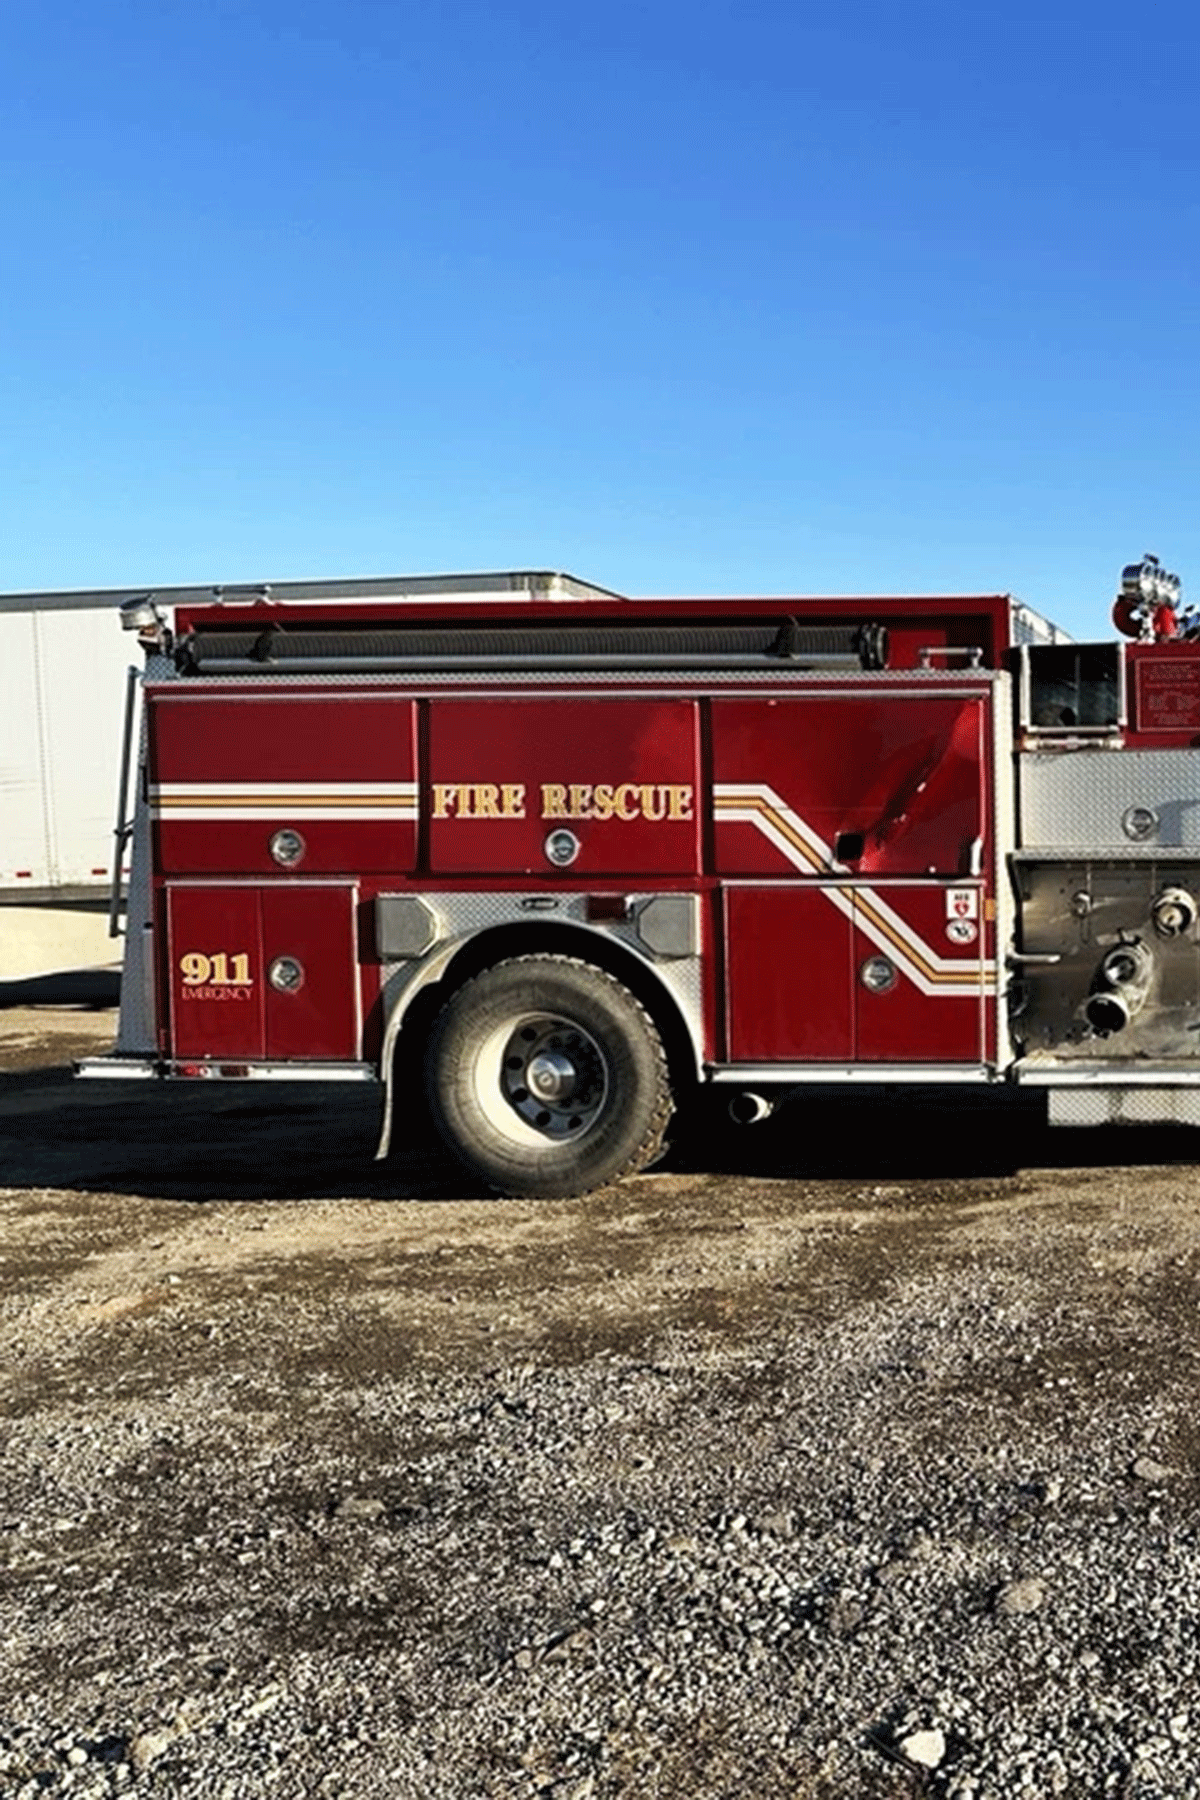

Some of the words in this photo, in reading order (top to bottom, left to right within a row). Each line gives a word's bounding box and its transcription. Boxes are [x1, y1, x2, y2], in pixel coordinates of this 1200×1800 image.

[431, 783, 526, 819] FIRE
[540, 783, 694, 820] RESCUE
[179, 952, 254, 985] 911
[181, 986, 253, 1000] EMERGENCY
